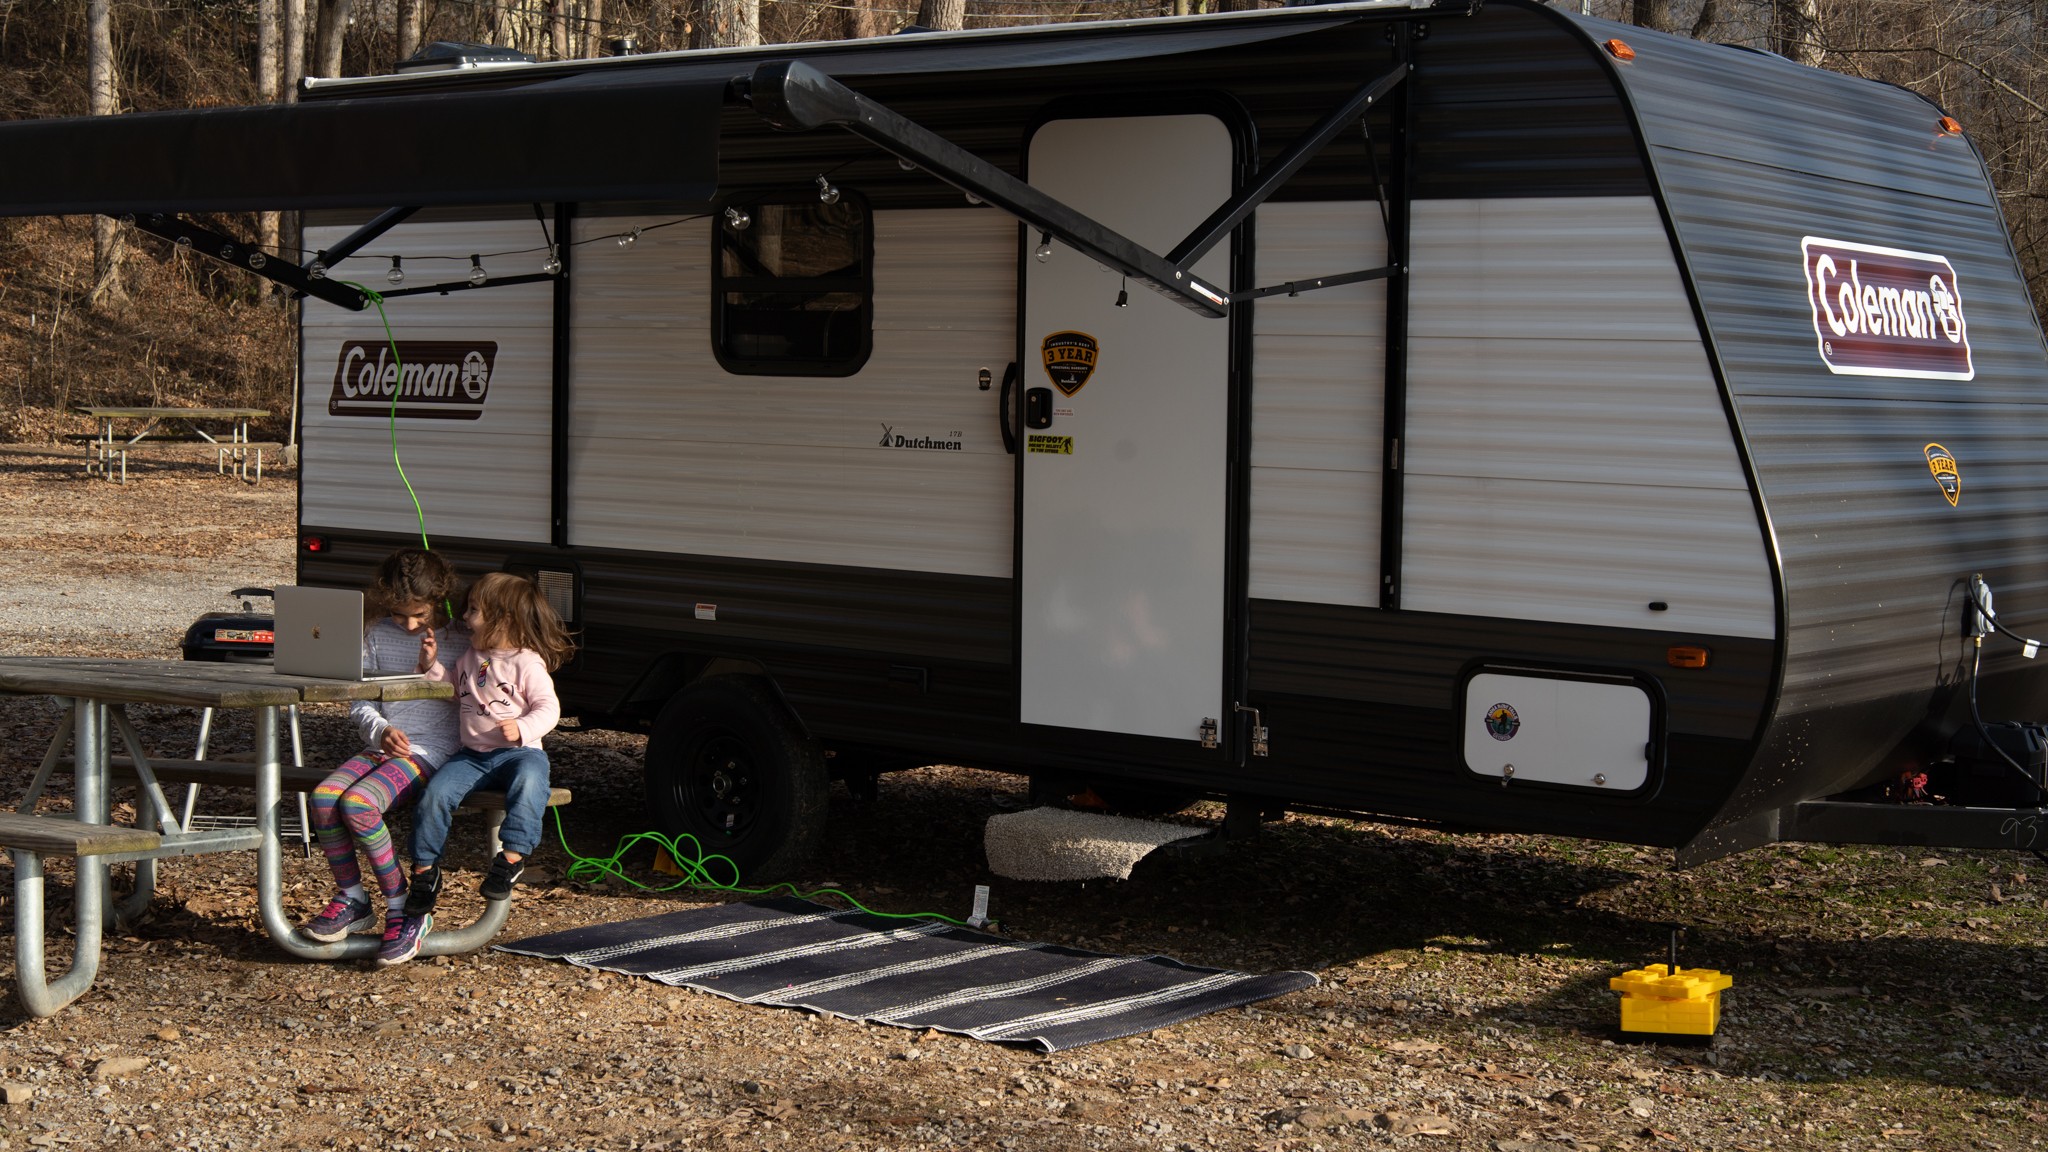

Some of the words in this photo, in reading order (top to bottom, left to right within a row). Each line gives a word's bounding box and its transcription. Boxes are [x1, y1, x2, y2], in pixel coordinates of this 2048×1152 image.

[1816, 253, 1937, 340] Coleman
[1047, 351, 1055, 362] 3
[1058, 348, 1093, 363] YEAR
[341, 346, 459, 398] Coleman
[895, 435, 962, 450] Dutchmen
[1029, 435, 1063, 443] BIGFOOT
[1932, 461, 1937, 473] 3
[1937, 459, 1955, 472] YEAR
